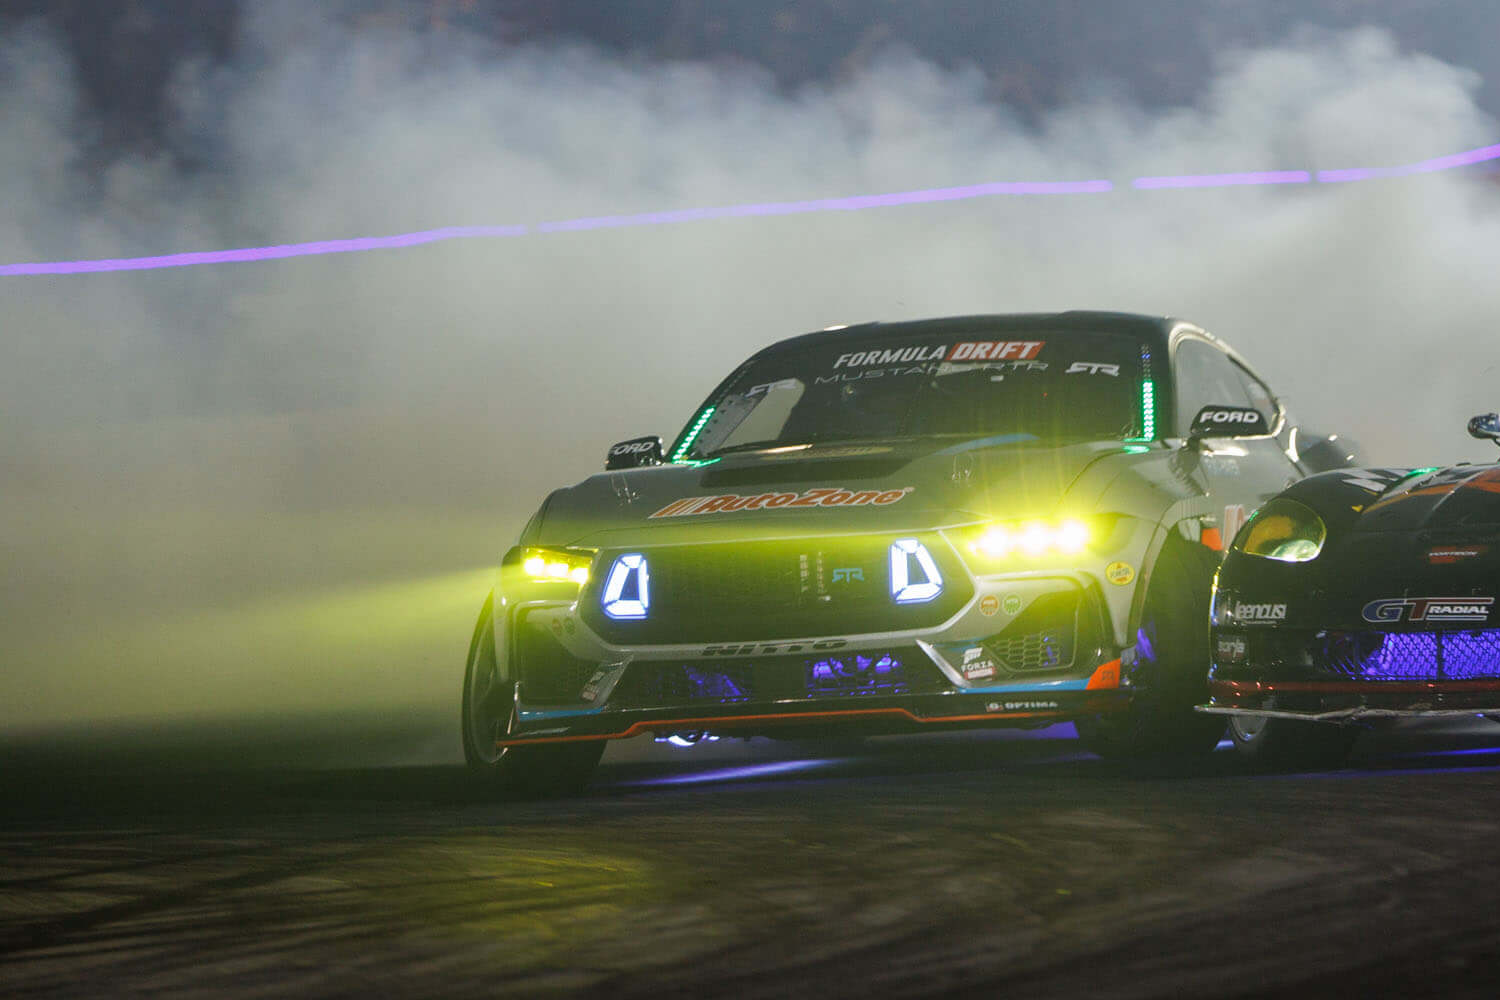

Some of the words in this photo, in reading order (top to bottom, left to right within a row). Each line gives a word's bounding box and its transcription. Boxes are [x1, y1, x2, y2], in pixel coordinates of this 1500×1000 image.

[833, 345, 947, 369] FORMULA
[951, 341, 1041, 361] DRIFT
[1200, 411, 1259, 423] FORD
[694, 487, 907, 514] AutoZone
[1428, 605, 1490, 615] RADIAL
[702, 639, 849, 656] NITTO
